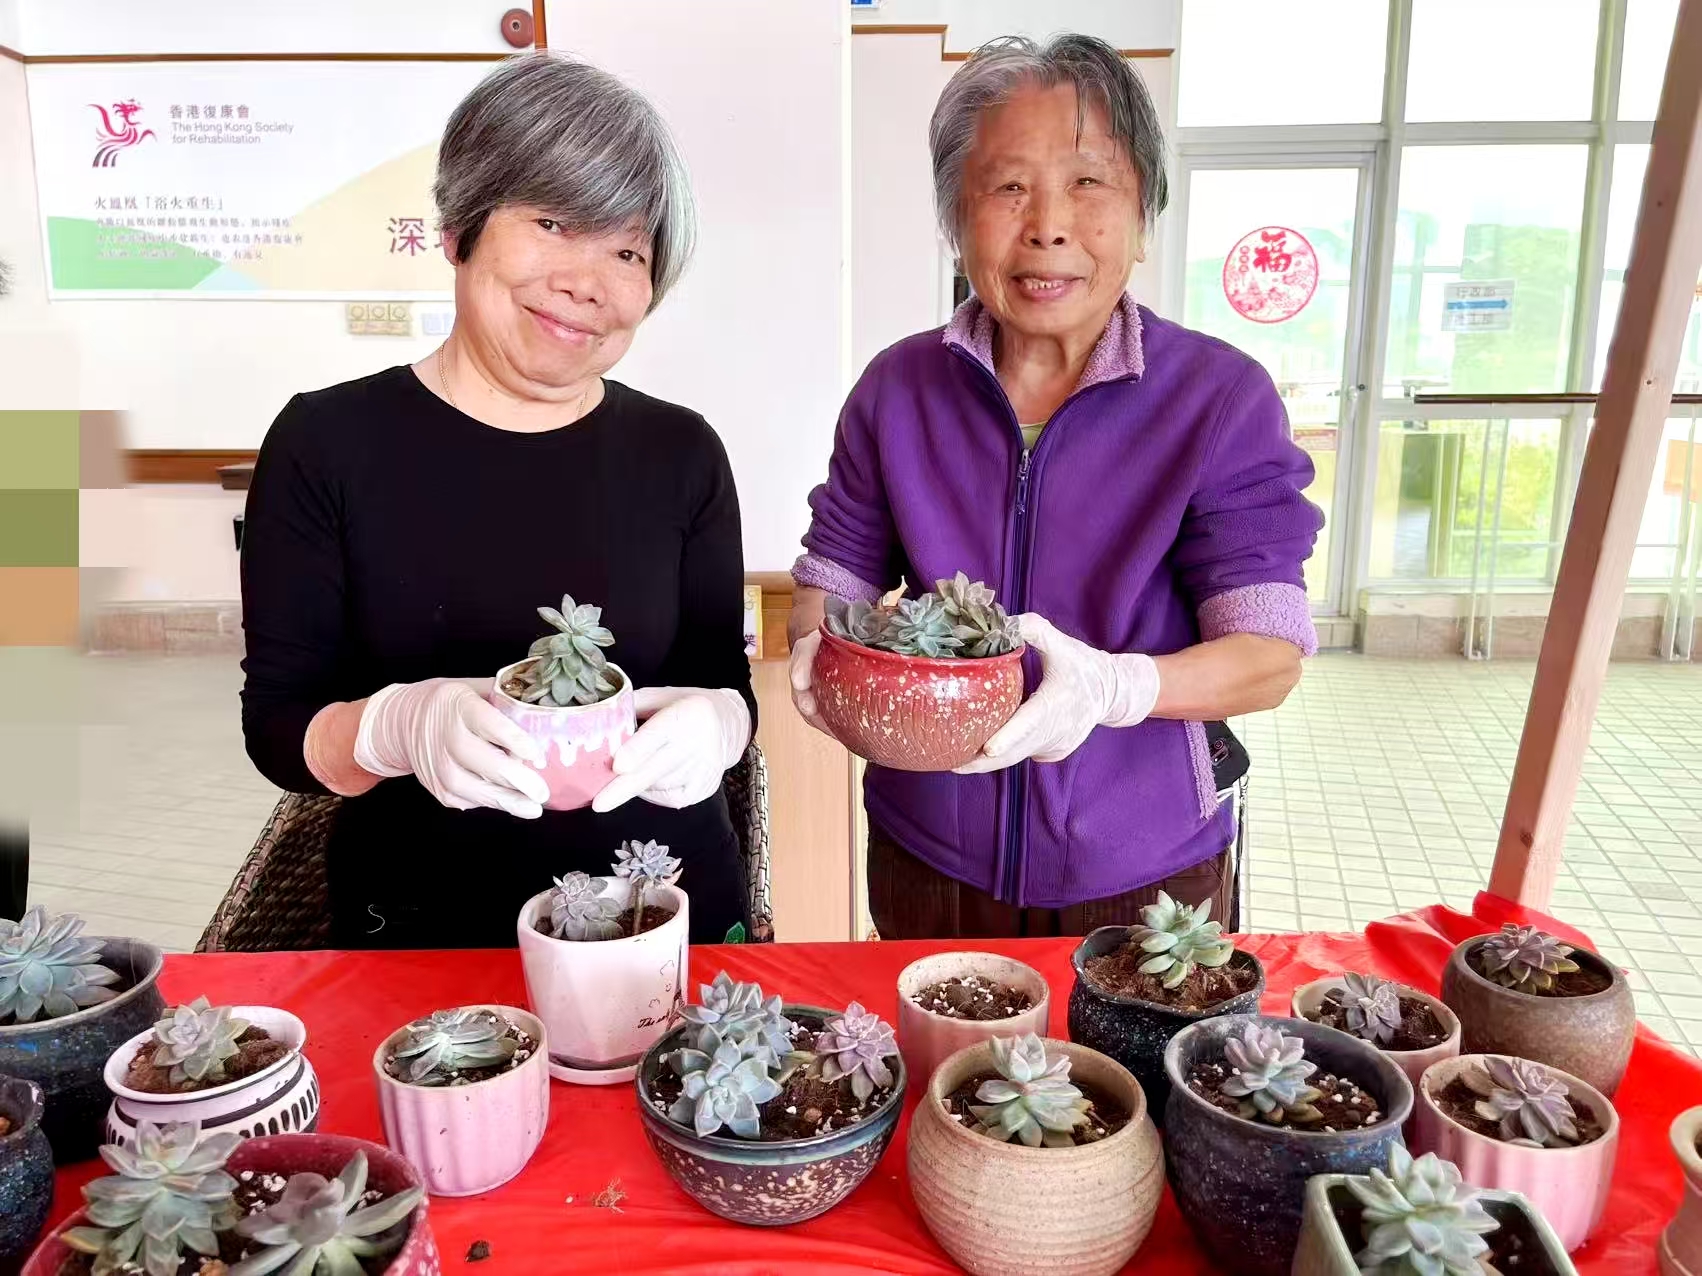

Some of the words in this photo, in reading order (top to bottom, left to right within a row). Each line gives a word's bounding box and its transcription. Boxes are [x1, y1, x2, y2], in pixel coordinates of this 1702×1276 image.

[169, 104, 250, 119] 香港復康會
[172, 122, 192, 132] The
[194, 122, 222, 134] Hong
[224, 122, 252, 134] Kong
[255, 121, 294, 134] Society
[172, 134, 186, 144] for
[188, 134, 261, 144] Rehabilitation
